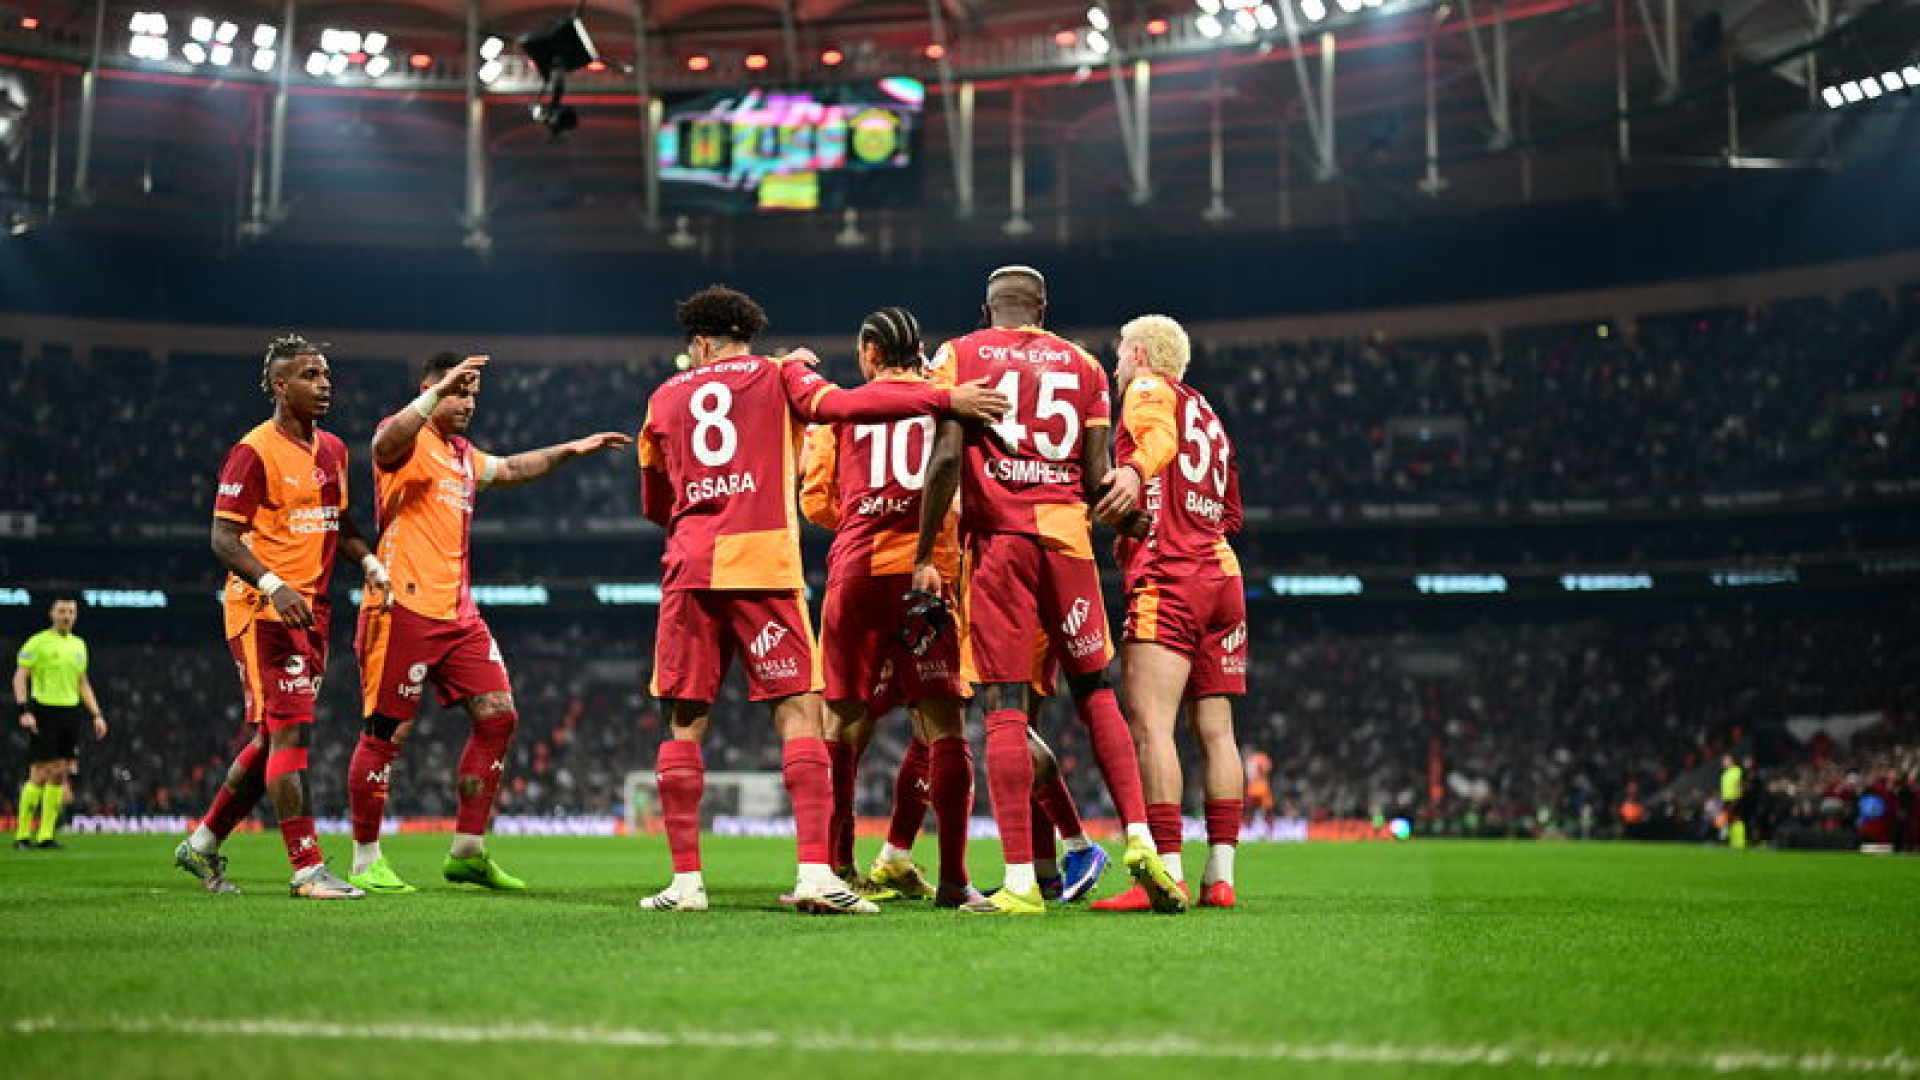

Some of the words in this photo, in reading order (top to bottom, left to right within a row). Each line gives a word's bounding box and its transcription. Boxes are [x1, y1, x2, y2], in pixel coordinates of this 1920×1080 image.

[688, 381, 738, 467] 8
[854, 414, 936, 490] 10
[987, 370, 1078, 460] 45
[1178, 396, 1230, 498] 53
[83, 589, 167, 608] TEMSA
